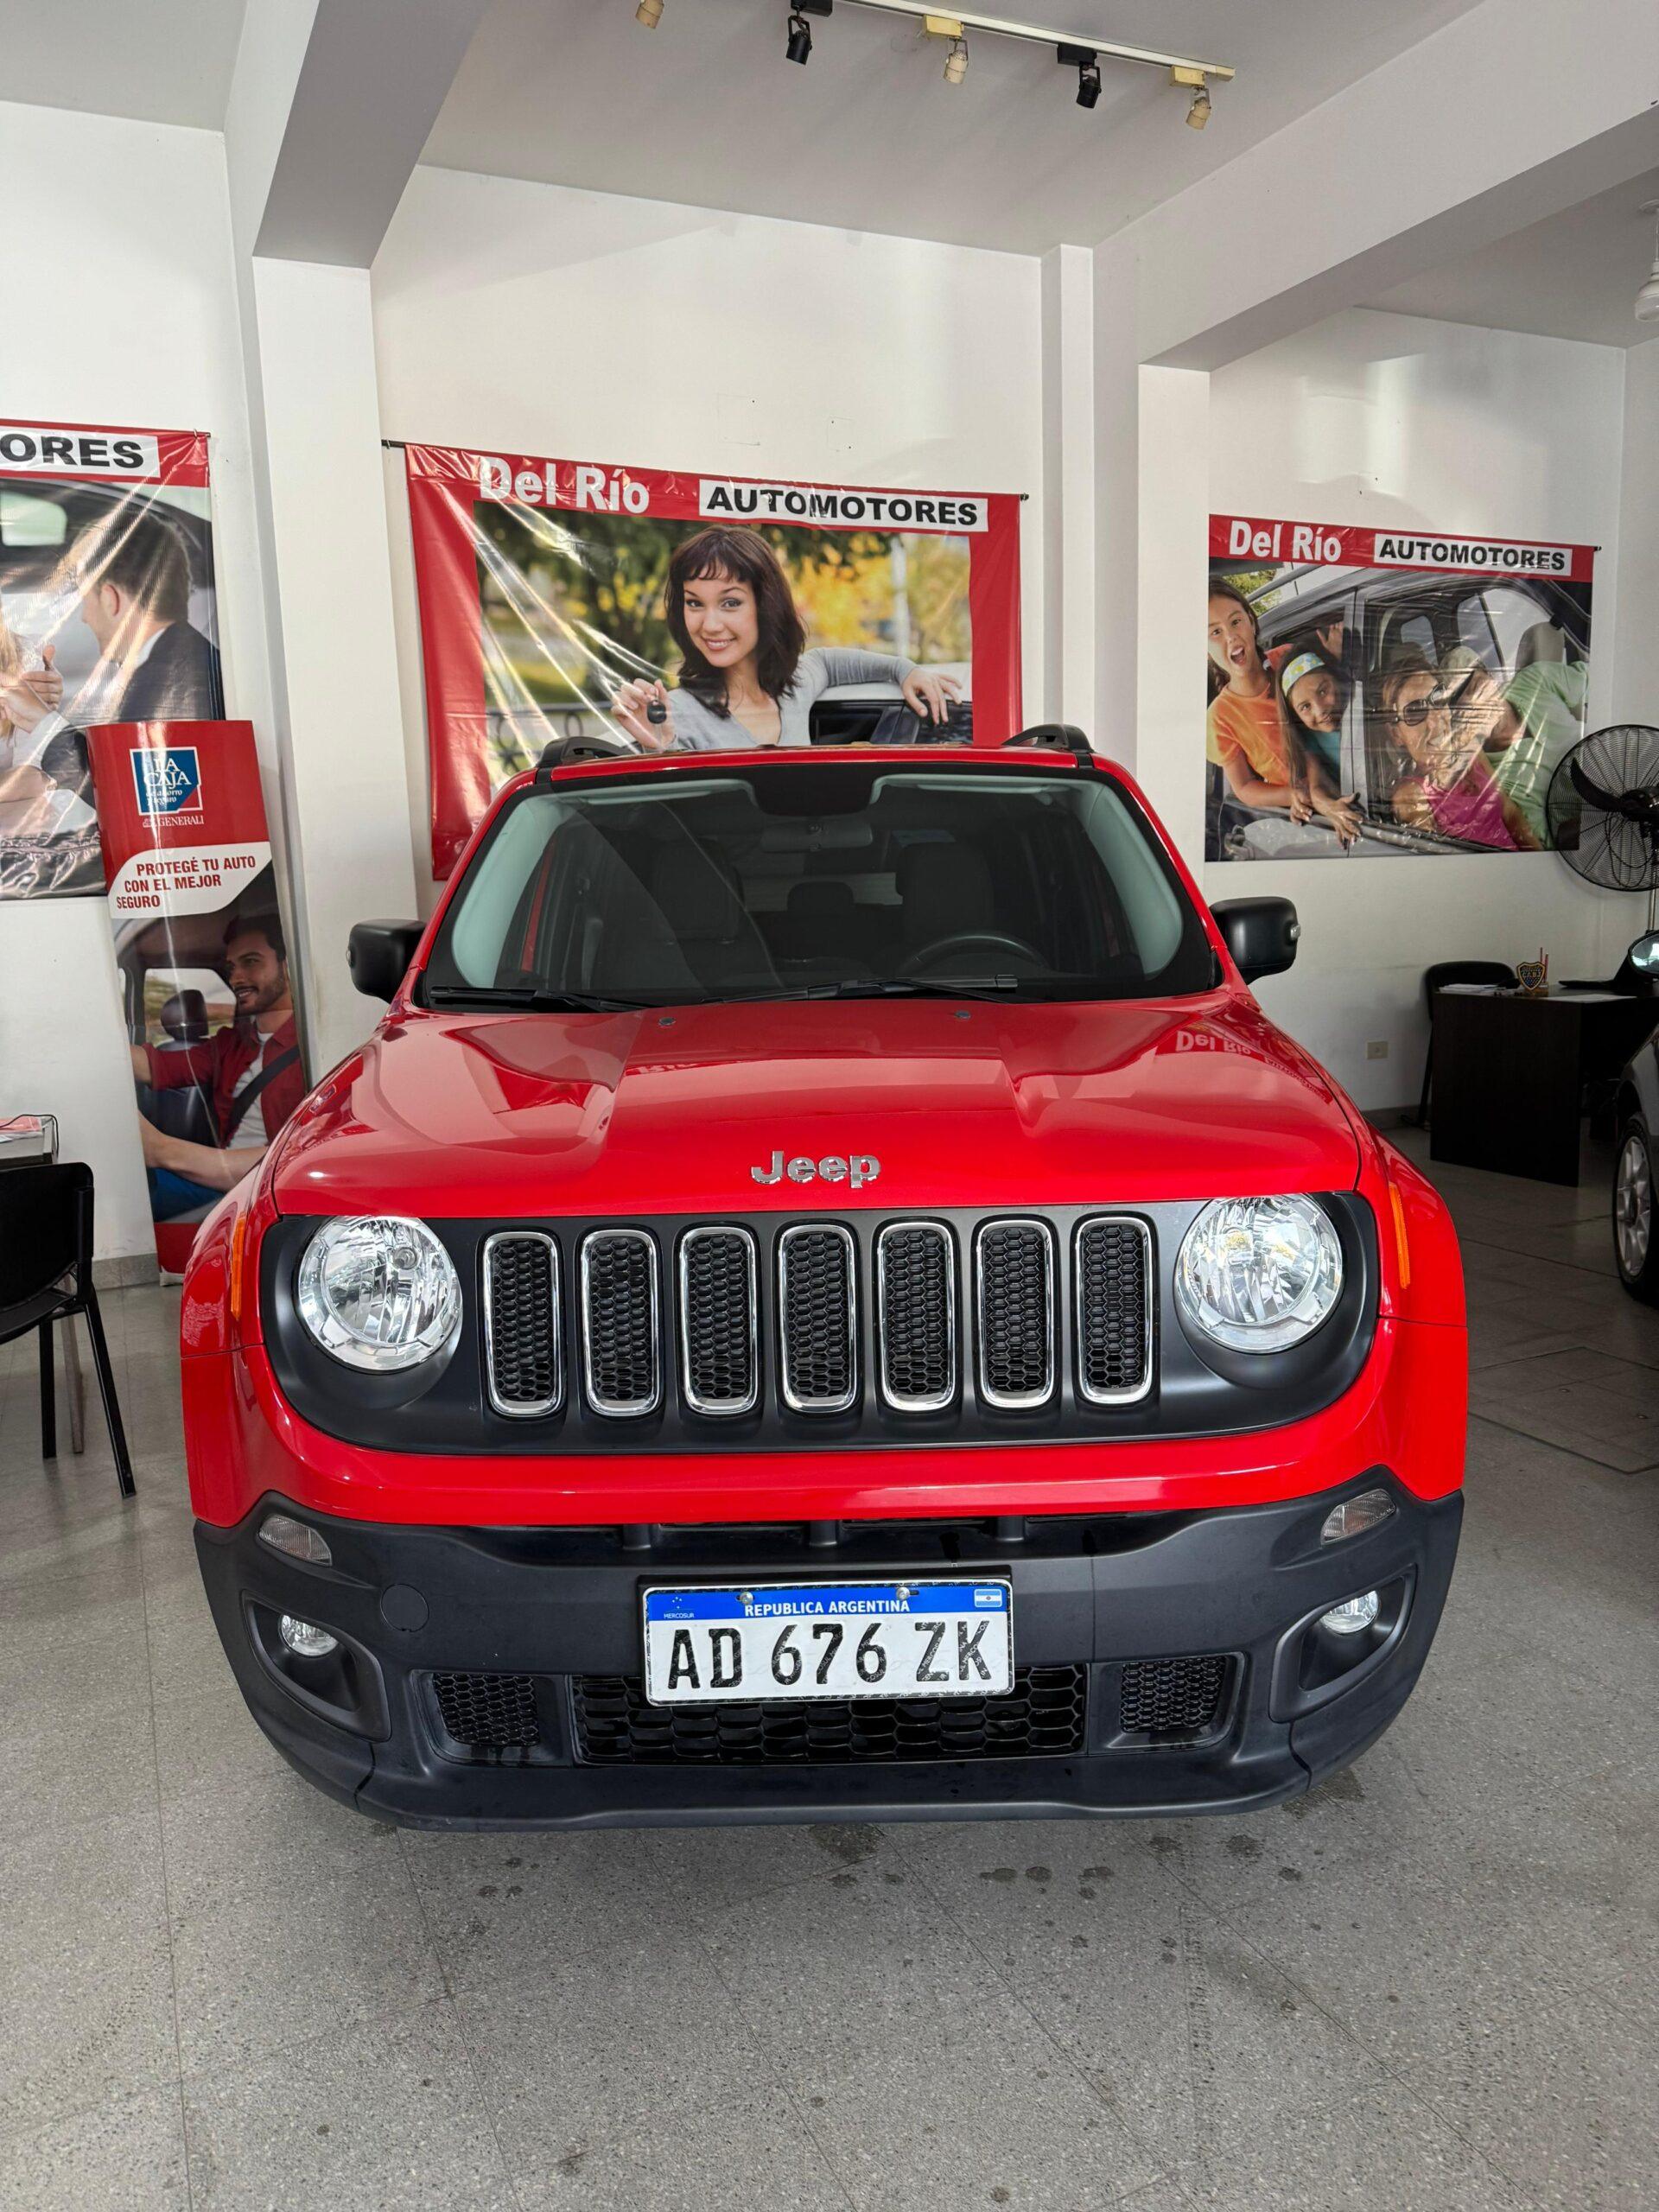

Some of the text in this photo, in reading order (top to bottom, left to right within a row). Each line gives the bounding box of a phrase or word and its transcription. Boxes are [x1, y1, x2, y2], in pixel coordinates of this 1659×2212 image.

[0, 433, 144, 468] ORES
[480, 456, 650, 514] Del Río
[707, 486, 978, 526] AUTOMOTORES
[1229, 520, 1342, 563] Del Río
[1379, 539, 1566, 571] AUTOMOTORES
[154, 758, 181, 772] LA
[144, 772, 192, 789] CAJA
[159, 815, 204, 827] GENERALI
[137, 855, 256, 876] PROTEGÉ TU AUTO
[124, 874, 221, 893] CON EL MEJOR
[117, 895, 161, 909] SEGURO
[751, 1151, 880, 1189] Jeep
[745, 1600, 910, 1618] REPUBLICA ARGENTINA
[668, 1620, 992, 1689] AD 676 ZK
